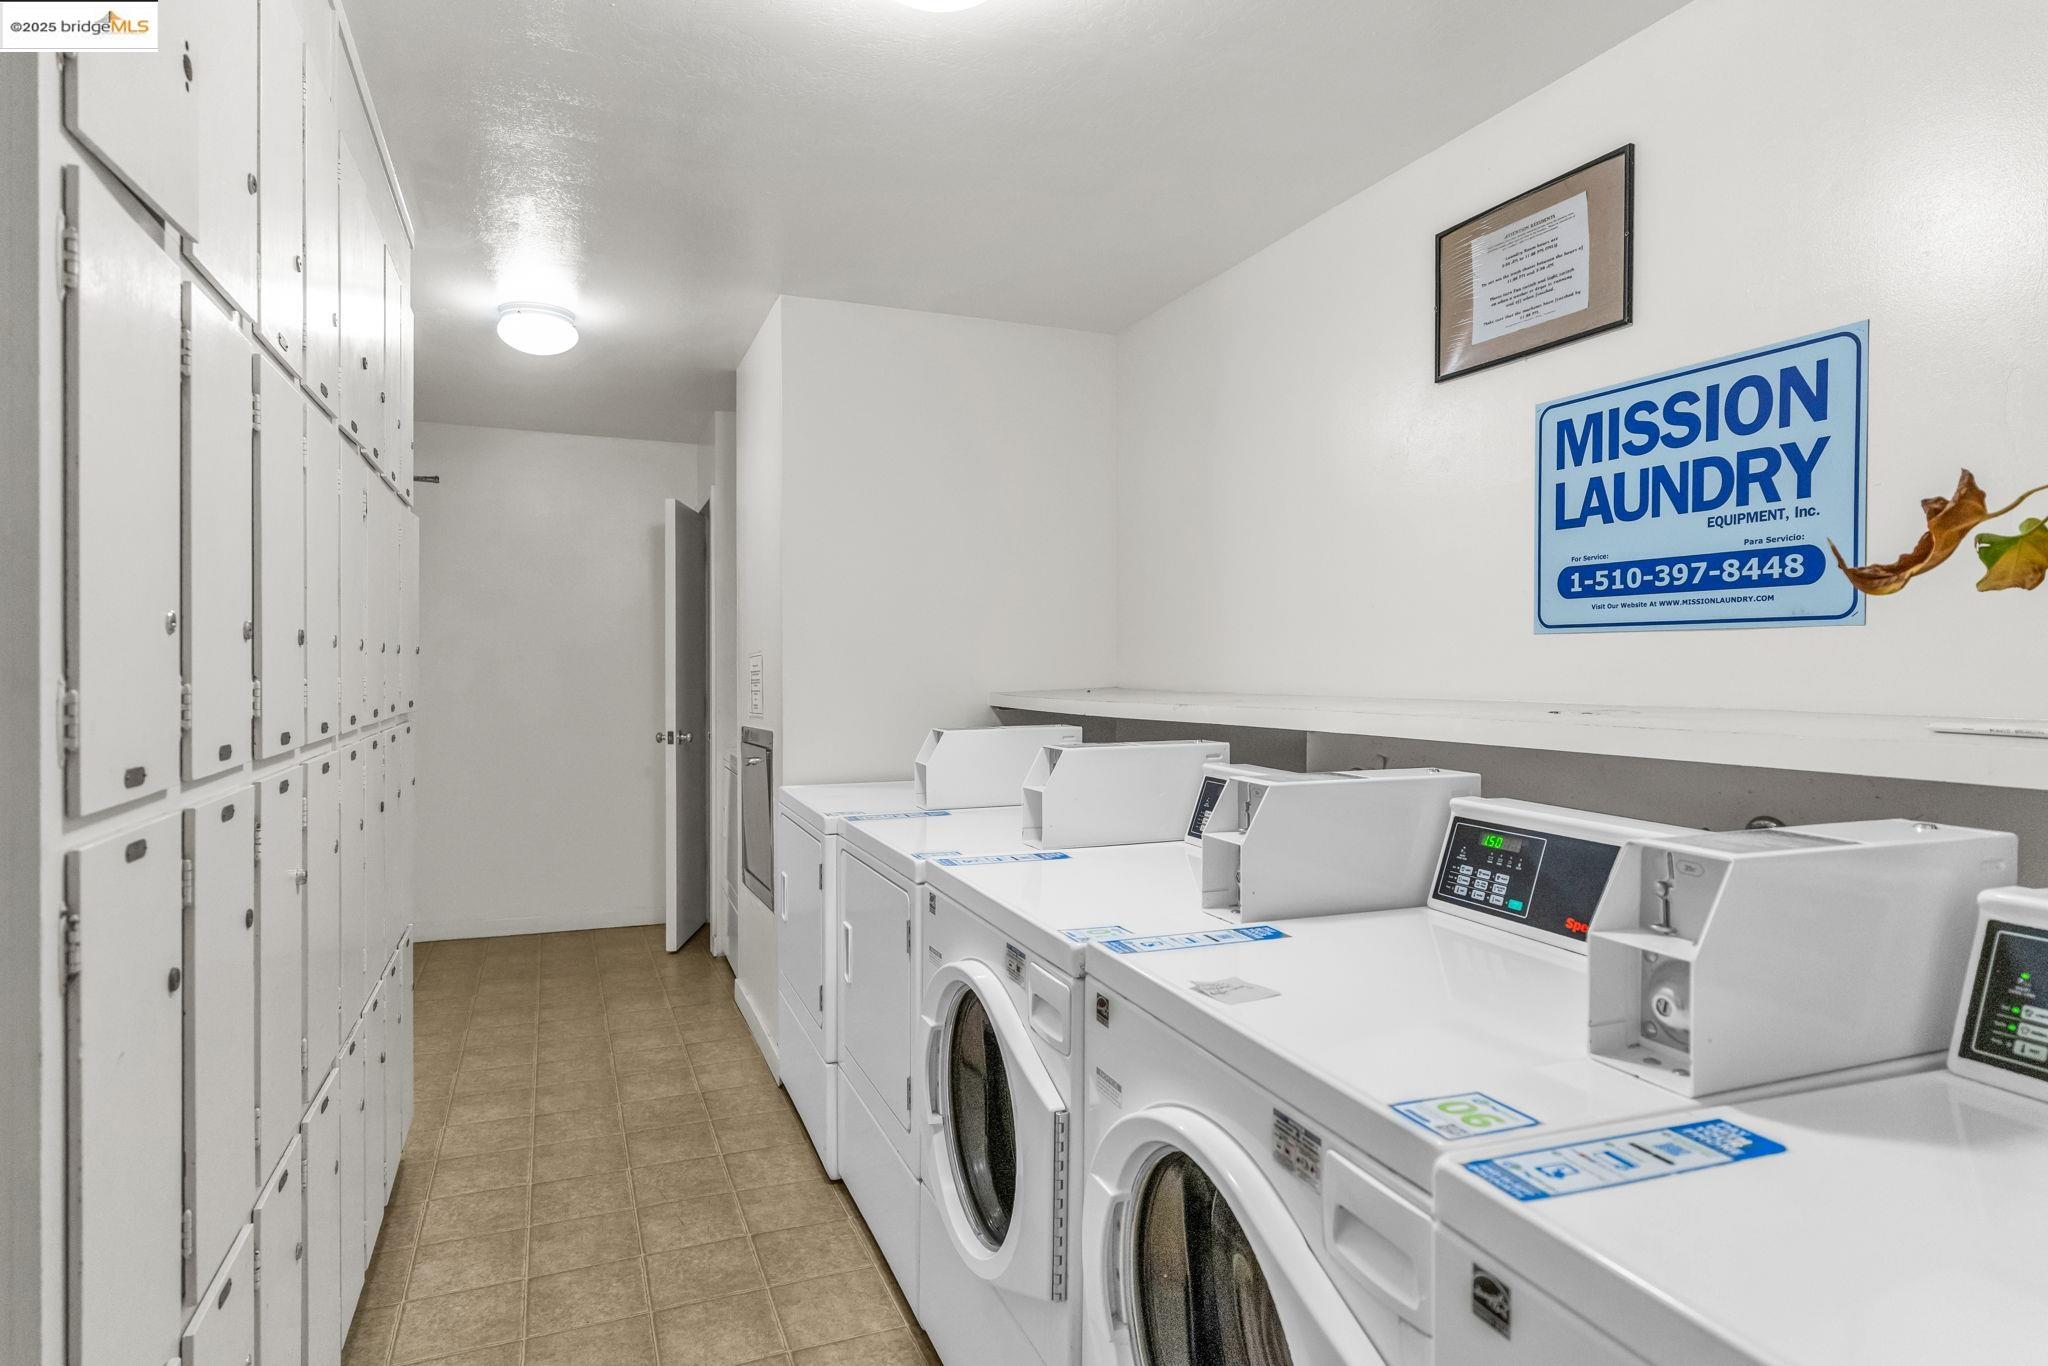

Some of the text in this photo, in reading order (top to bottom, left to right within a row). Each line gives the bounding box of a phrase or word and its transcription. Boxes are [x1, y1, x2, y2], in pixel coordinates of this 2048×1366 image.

[1556, 358, 1829, 471] MISSION
[1555, 435, 1831, 531] LAUNDRY
[1706, 505, 1820, 529] EQUIPMENT, Inc.
[1743, 533, 1805, 546] Para Servicio:
[1583, 553, 1609, 562] Service:
[1570, 553, 1805, 593] 1-510-397-8448
[1607, 602, 1619, 610] Our
[1620, 600, 1648, 609] Website
[1649, 600, 1658, 608] At
[1658, 593, 1775, 607] WWW.MISSIONLAUNDRY.COM
